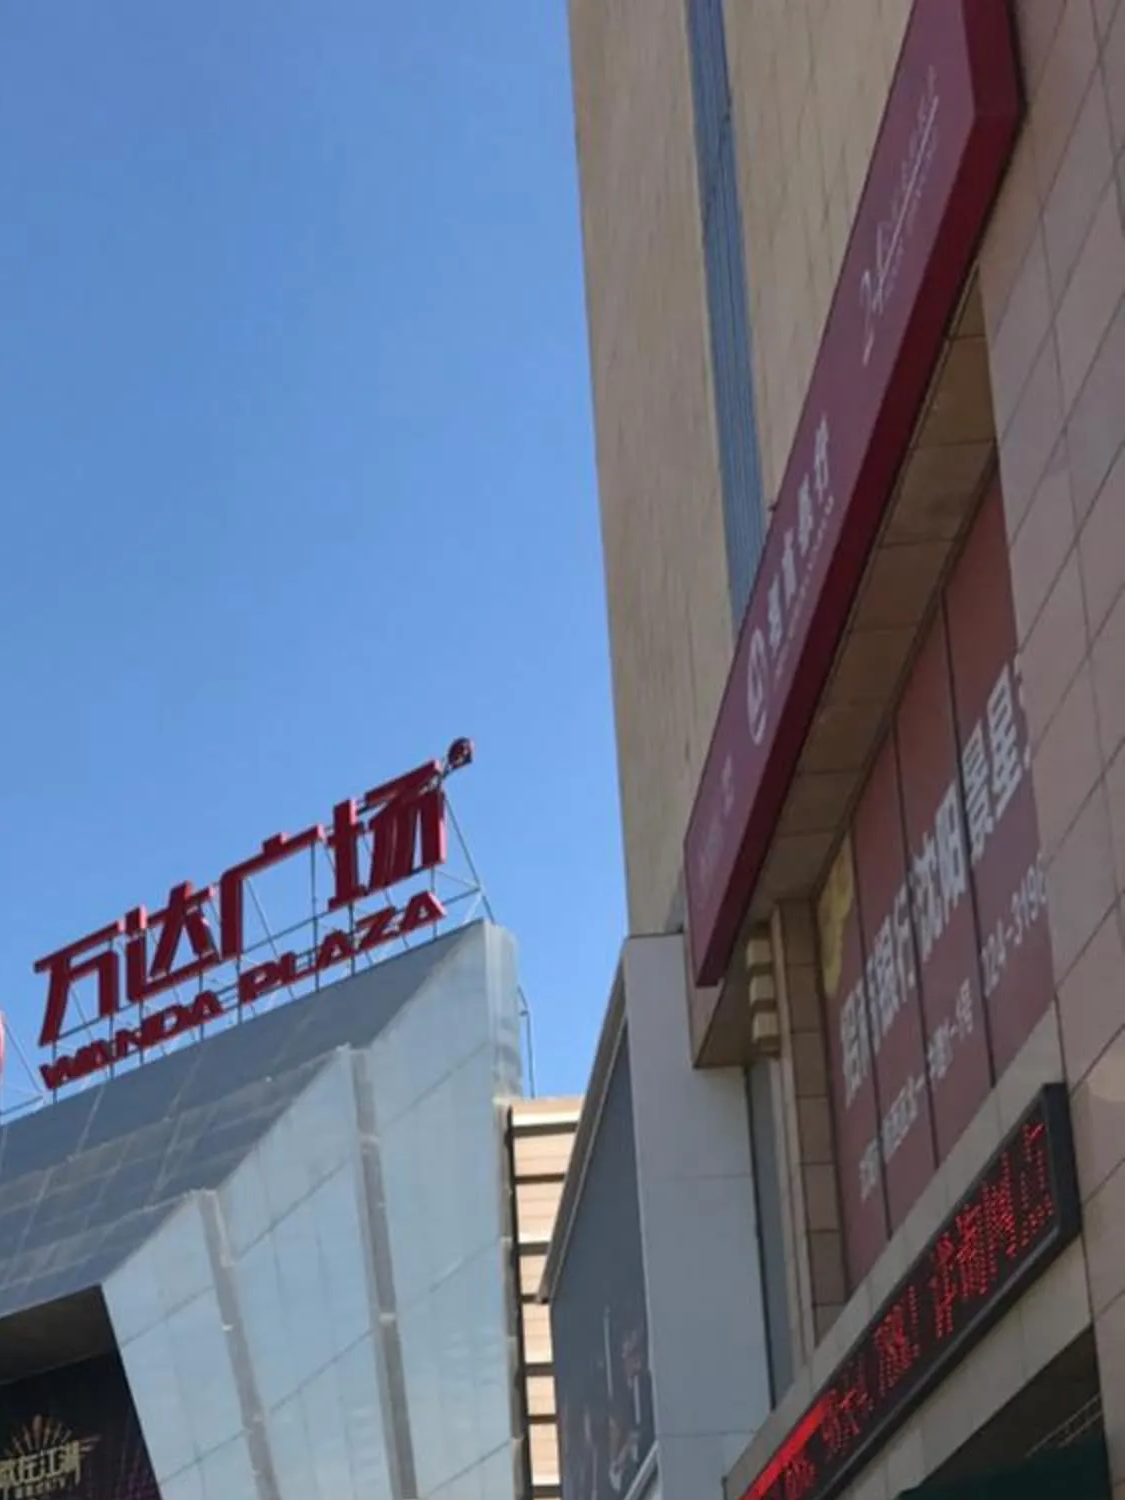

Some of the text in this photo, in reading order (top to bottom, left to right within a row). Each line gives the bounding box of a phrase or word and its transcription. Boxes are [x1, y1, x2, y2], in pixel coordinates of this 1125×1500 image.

[32, 758, 449, 1048] 万达广场
[39, 890, 448, 1092] WANDA PLAZA
